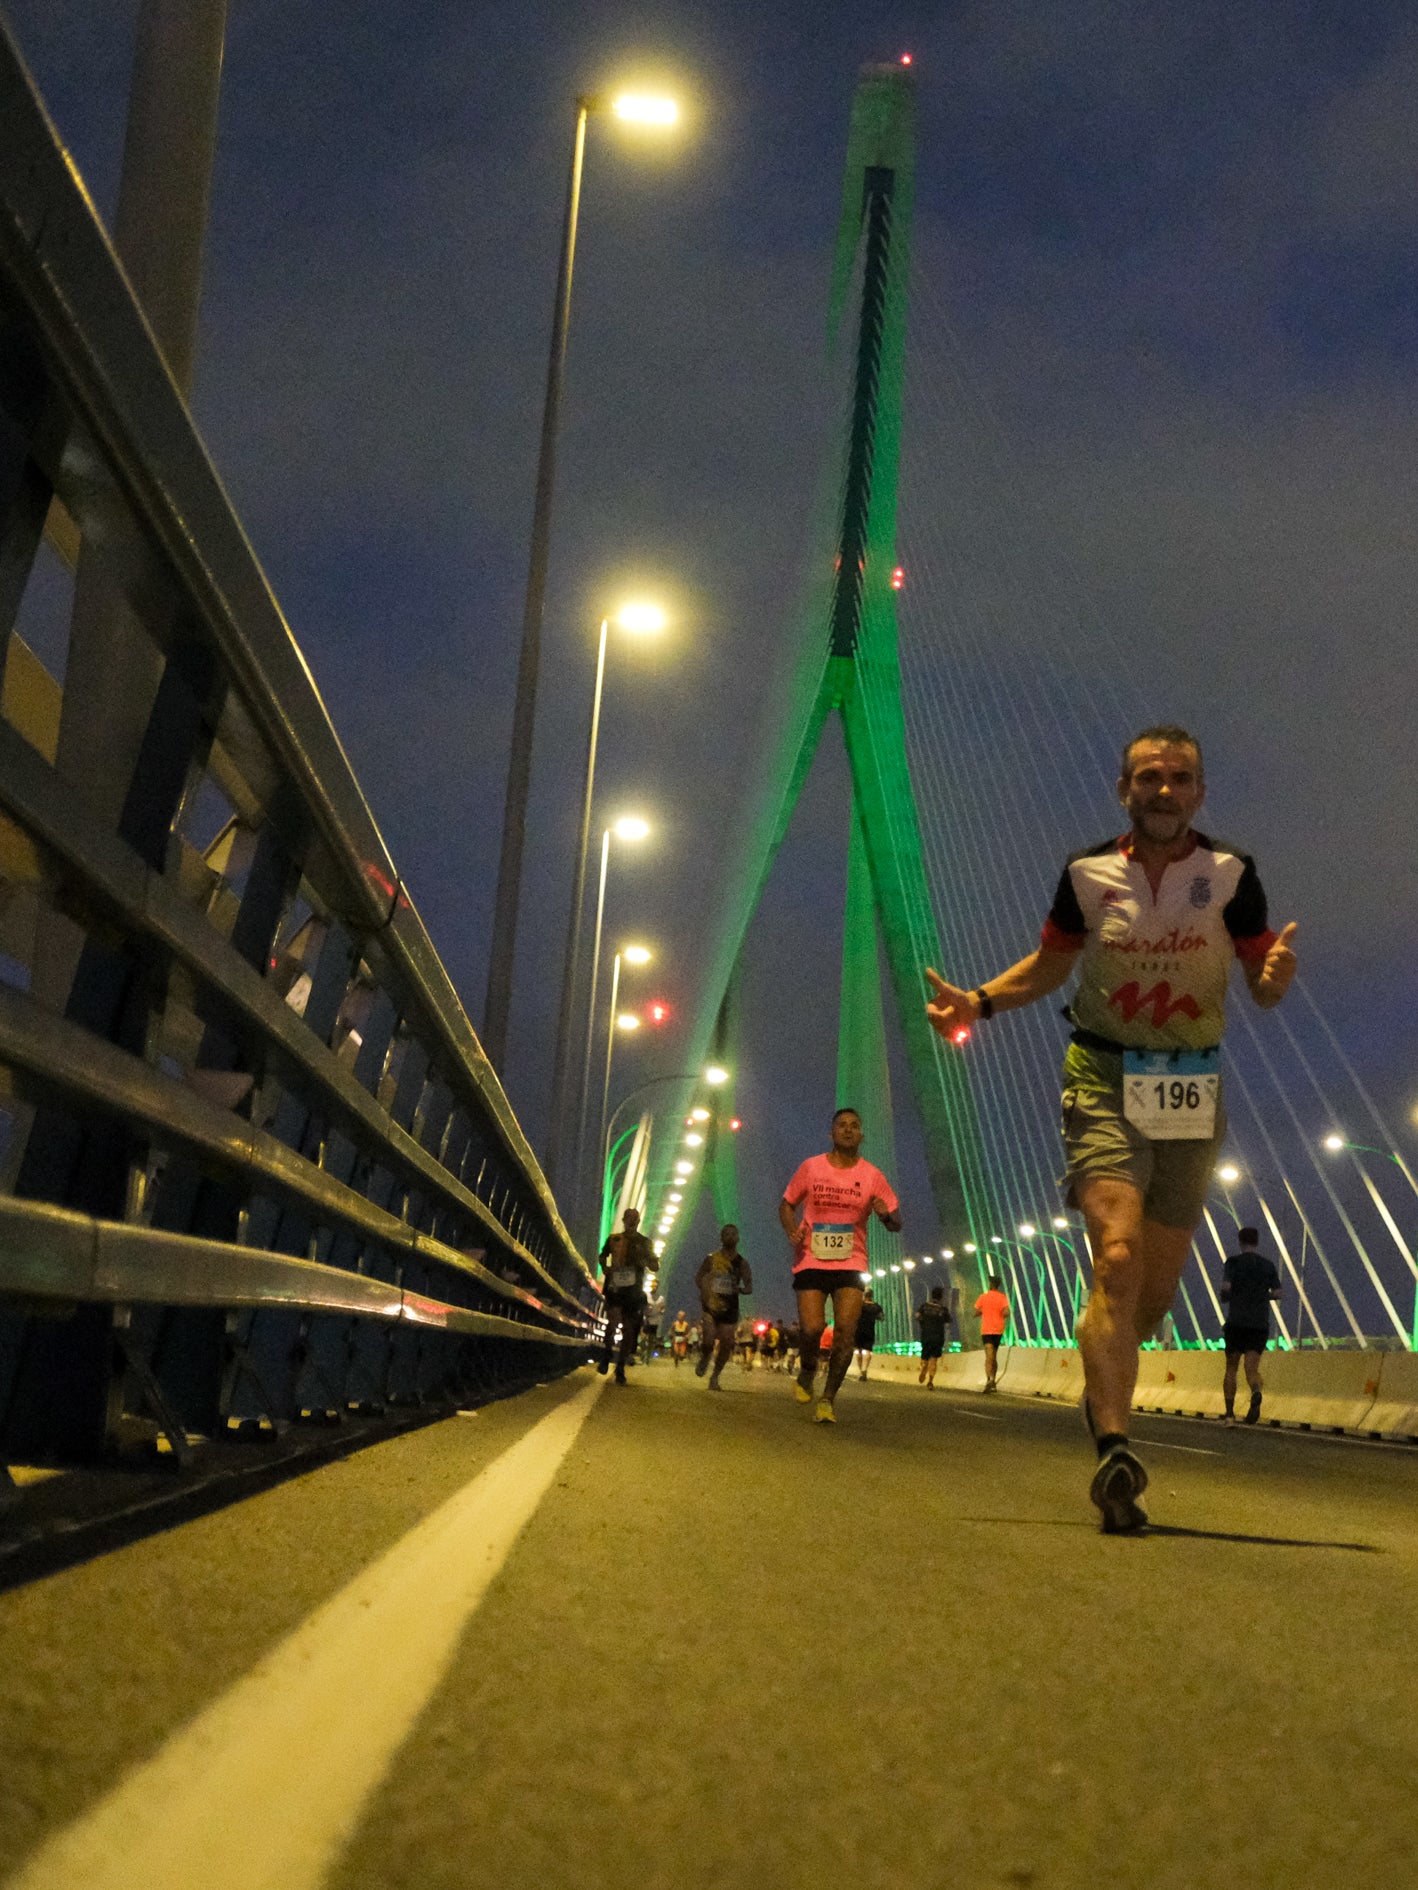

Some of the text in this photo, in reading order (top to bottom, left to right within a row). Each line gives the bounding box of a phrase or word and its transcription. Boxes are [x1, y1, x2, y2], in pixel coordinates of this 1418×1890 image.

[1154, 1081, 1200, 1110] 196
[813, 1193, 840, 1201] contra
[826, 1186, 861, 1197] marcha
[824, 1236, 843, 1247] 132
